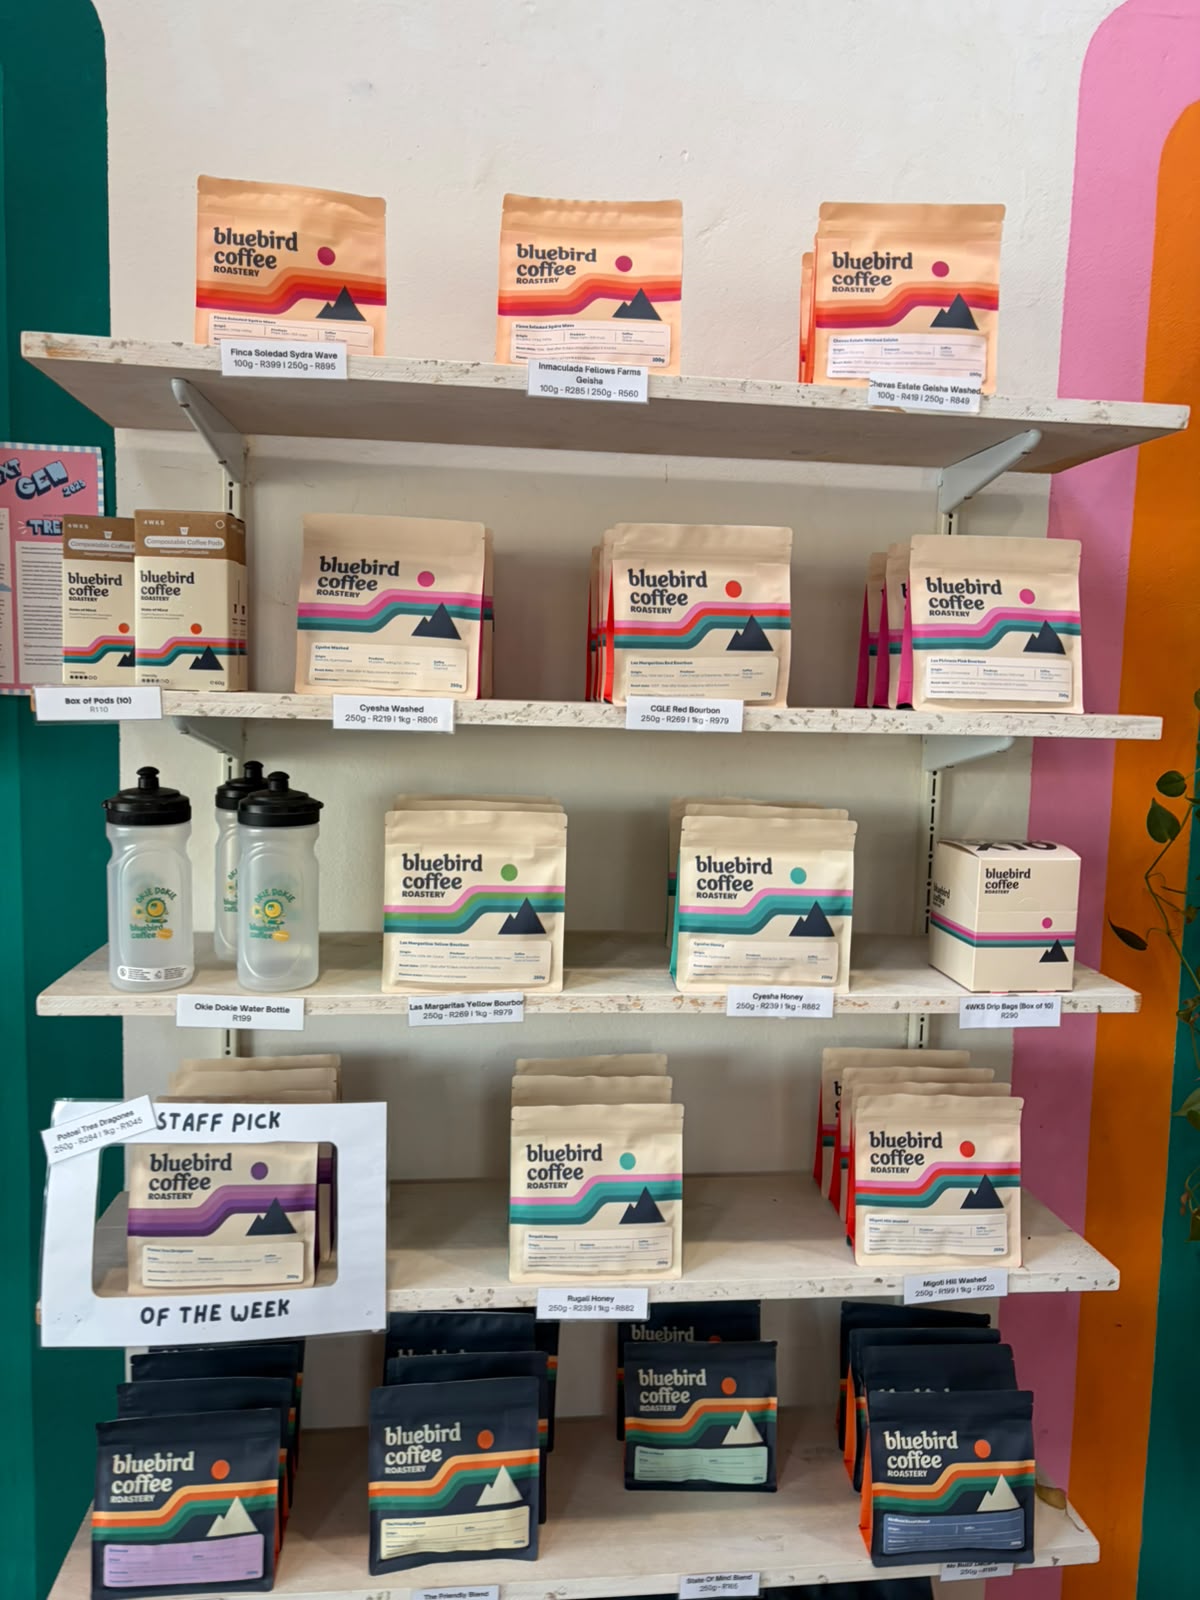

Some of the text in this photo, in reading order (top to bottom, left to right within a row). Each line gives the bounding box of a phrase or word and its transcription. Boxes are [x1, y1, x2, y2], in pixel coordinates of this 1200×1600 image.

[213, 226, 298, 252] bluebird
[214, 248, 277, 269] coffee
[516, 244, 597, 263] bluebird
[832, 251, 913, 270] bluebird
[214, 266, 260, 277] ROASTERY
[517, 261, 576, 277] coffee
[832, 272, 892, 286] coffee
[230, 348, 252, 356] Finca
[254, 349, 288, 357] Soledad
[290, 350, 312, 359] Sydra
[234, 360, 253, 369] 100g
[288, 361, 308, 370] 250g
[538, 362, 583, 372] Inmaculada
[585, 366, 615, 374] Fellows
[576, 376, 603, 385] Geisha
[897, 382, 920, 391] Estate
[922, 384, 948, 393] Geisha
[540, 385, 558, 394] 100g
[565, 386, 585, 394] R285
[592, 388, 612, 398] 250g
[878, 392, 895, 401] 100g
[901, 393, 918, 401] R419
[925, 395, 944, 404] 250g
[320, 556, 400, 576] bluebird
[68, 572, 122, 586] bluebird
[140, 570, 195, 584] bluebird
[318, 575, 378, 591] coffee
[628, 569, 708, 588] bluebird
[68, 585, 109, 597] coffee
[141, 584, 181, 596] coffee
[317, 589, 360, 598] ROASTERY
[926, 577, 1002, 595] bluebird
[630, 590, 688, 606] coffee
[929, 595, 984, 610] coffee
[630, 606, 672, 614] ROASTERY
[360, 704, 389, 712] Cyesha
[345, 714, 366, 723] 250g
[398, 716, 411, 724] 1kg
[641, 715, 660, 723] 250g
[691, 716, 703, 724] 1kg
[402, 853, 483, 871] bluebird
[695, 856, 773, 875] bluebird
[402, 873, 462, 889] coffee
[985, 868, 1031, 879] bluebird
[697, 875, 753, 892] coffee
[986, 878, 1019, 889] coffee
[425, 1001, 465, 1011] Margaritas
[156, 1110, 281, 1133] STAFF PICK
[869, 1131, 942, 1149] bluebird
[526, 1143, 603, 1162] bluebird
[870, 1150, 924, 1166] coffee
[150, 1153, 232, 1172] bluebird
[527, 1163, 584, 1181] coffee
[149, 1173, 211, 1192] coffee
[148, 1192, 193, 1201] ROASTERY
[923, 1278, 944, 1287] Migoti
[959, 1276, 987, 1284] Washed
[591, 1295, 615, 1303] Honey
[140, 1299, 290, 1327] OF THE WEEK
[631, 1325, 695, 1342] bluebird
[638, 1368, 707, 1386] bluebird
[640, 1387, 690, 1403] coffee
[384, 1422, 461, 1446] bluebird
[883, 1430, 958, 1450] bluebird
[113, 1451, 195, 1474] bluebird
[385, 1446, 442, 1465] coffee
[887, 1450, 942, 1469] coffee
[111, 1474, 173, 1494] coffee
